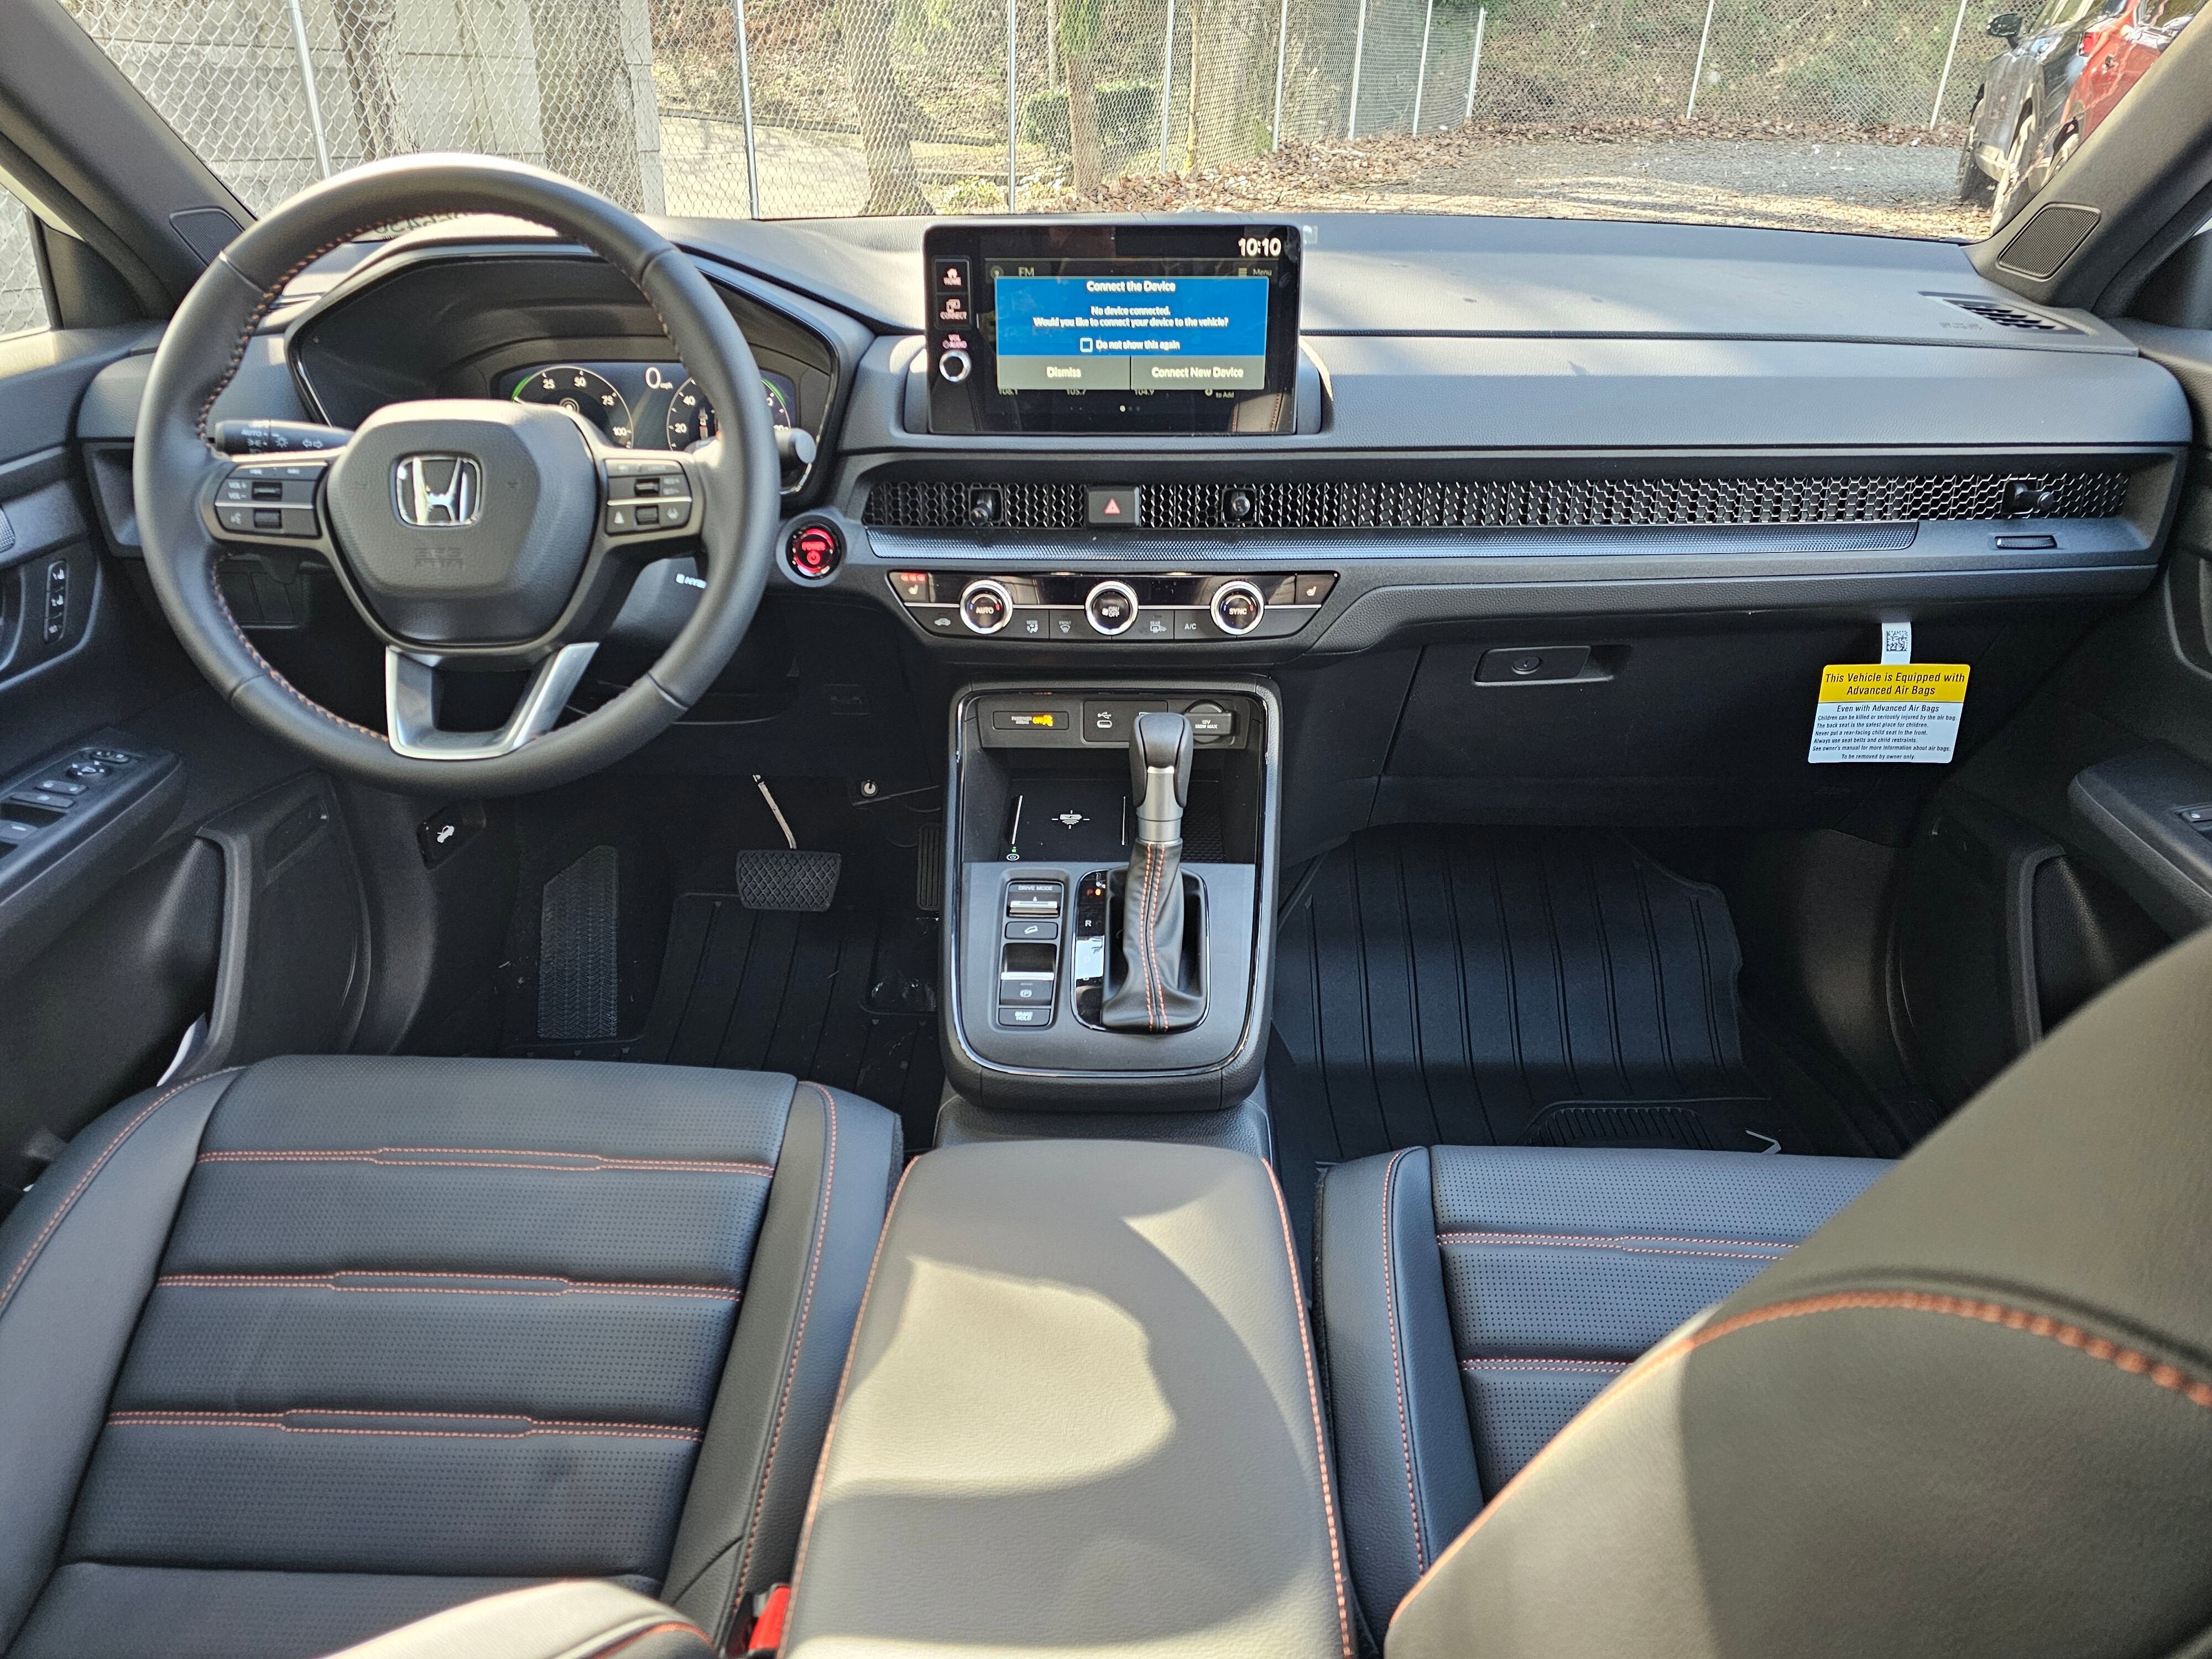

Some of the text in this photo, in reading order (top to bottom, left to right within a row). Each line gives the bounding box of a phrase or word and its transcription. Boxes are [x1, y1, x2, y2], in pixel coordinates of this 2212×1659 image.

[1238, 237, 1281, 257] 10:10
[1018, 267, 1034, 276] FM
[1086, 280, 1176, 292] Connect the Device
[1091, 306, 1171, 316] No device connected.
[1032, 317, 1229, 328] Would you like to connect your device to the vehicle?
[1095, 340, 1180, 351] Do not show this again
[1046, 367, 1082, 378] Dismiss
[1151, 367, 1244, 378] Connect New Device
[542, 378, 555, 389] 25
[574, 377, 586, 388] 50
[601, 395, 614, 406] 75
[683, 395, 695, 406] 40
[241, 429, 262, 437] AUTO
[613, 426, 627, 436] 100
[675, 423, 687, 433] 20
[1826, 672, 1965, 684] This Vehicle is Equipped with
[1846, 686, 1936, 696] Advanced Air Bags
